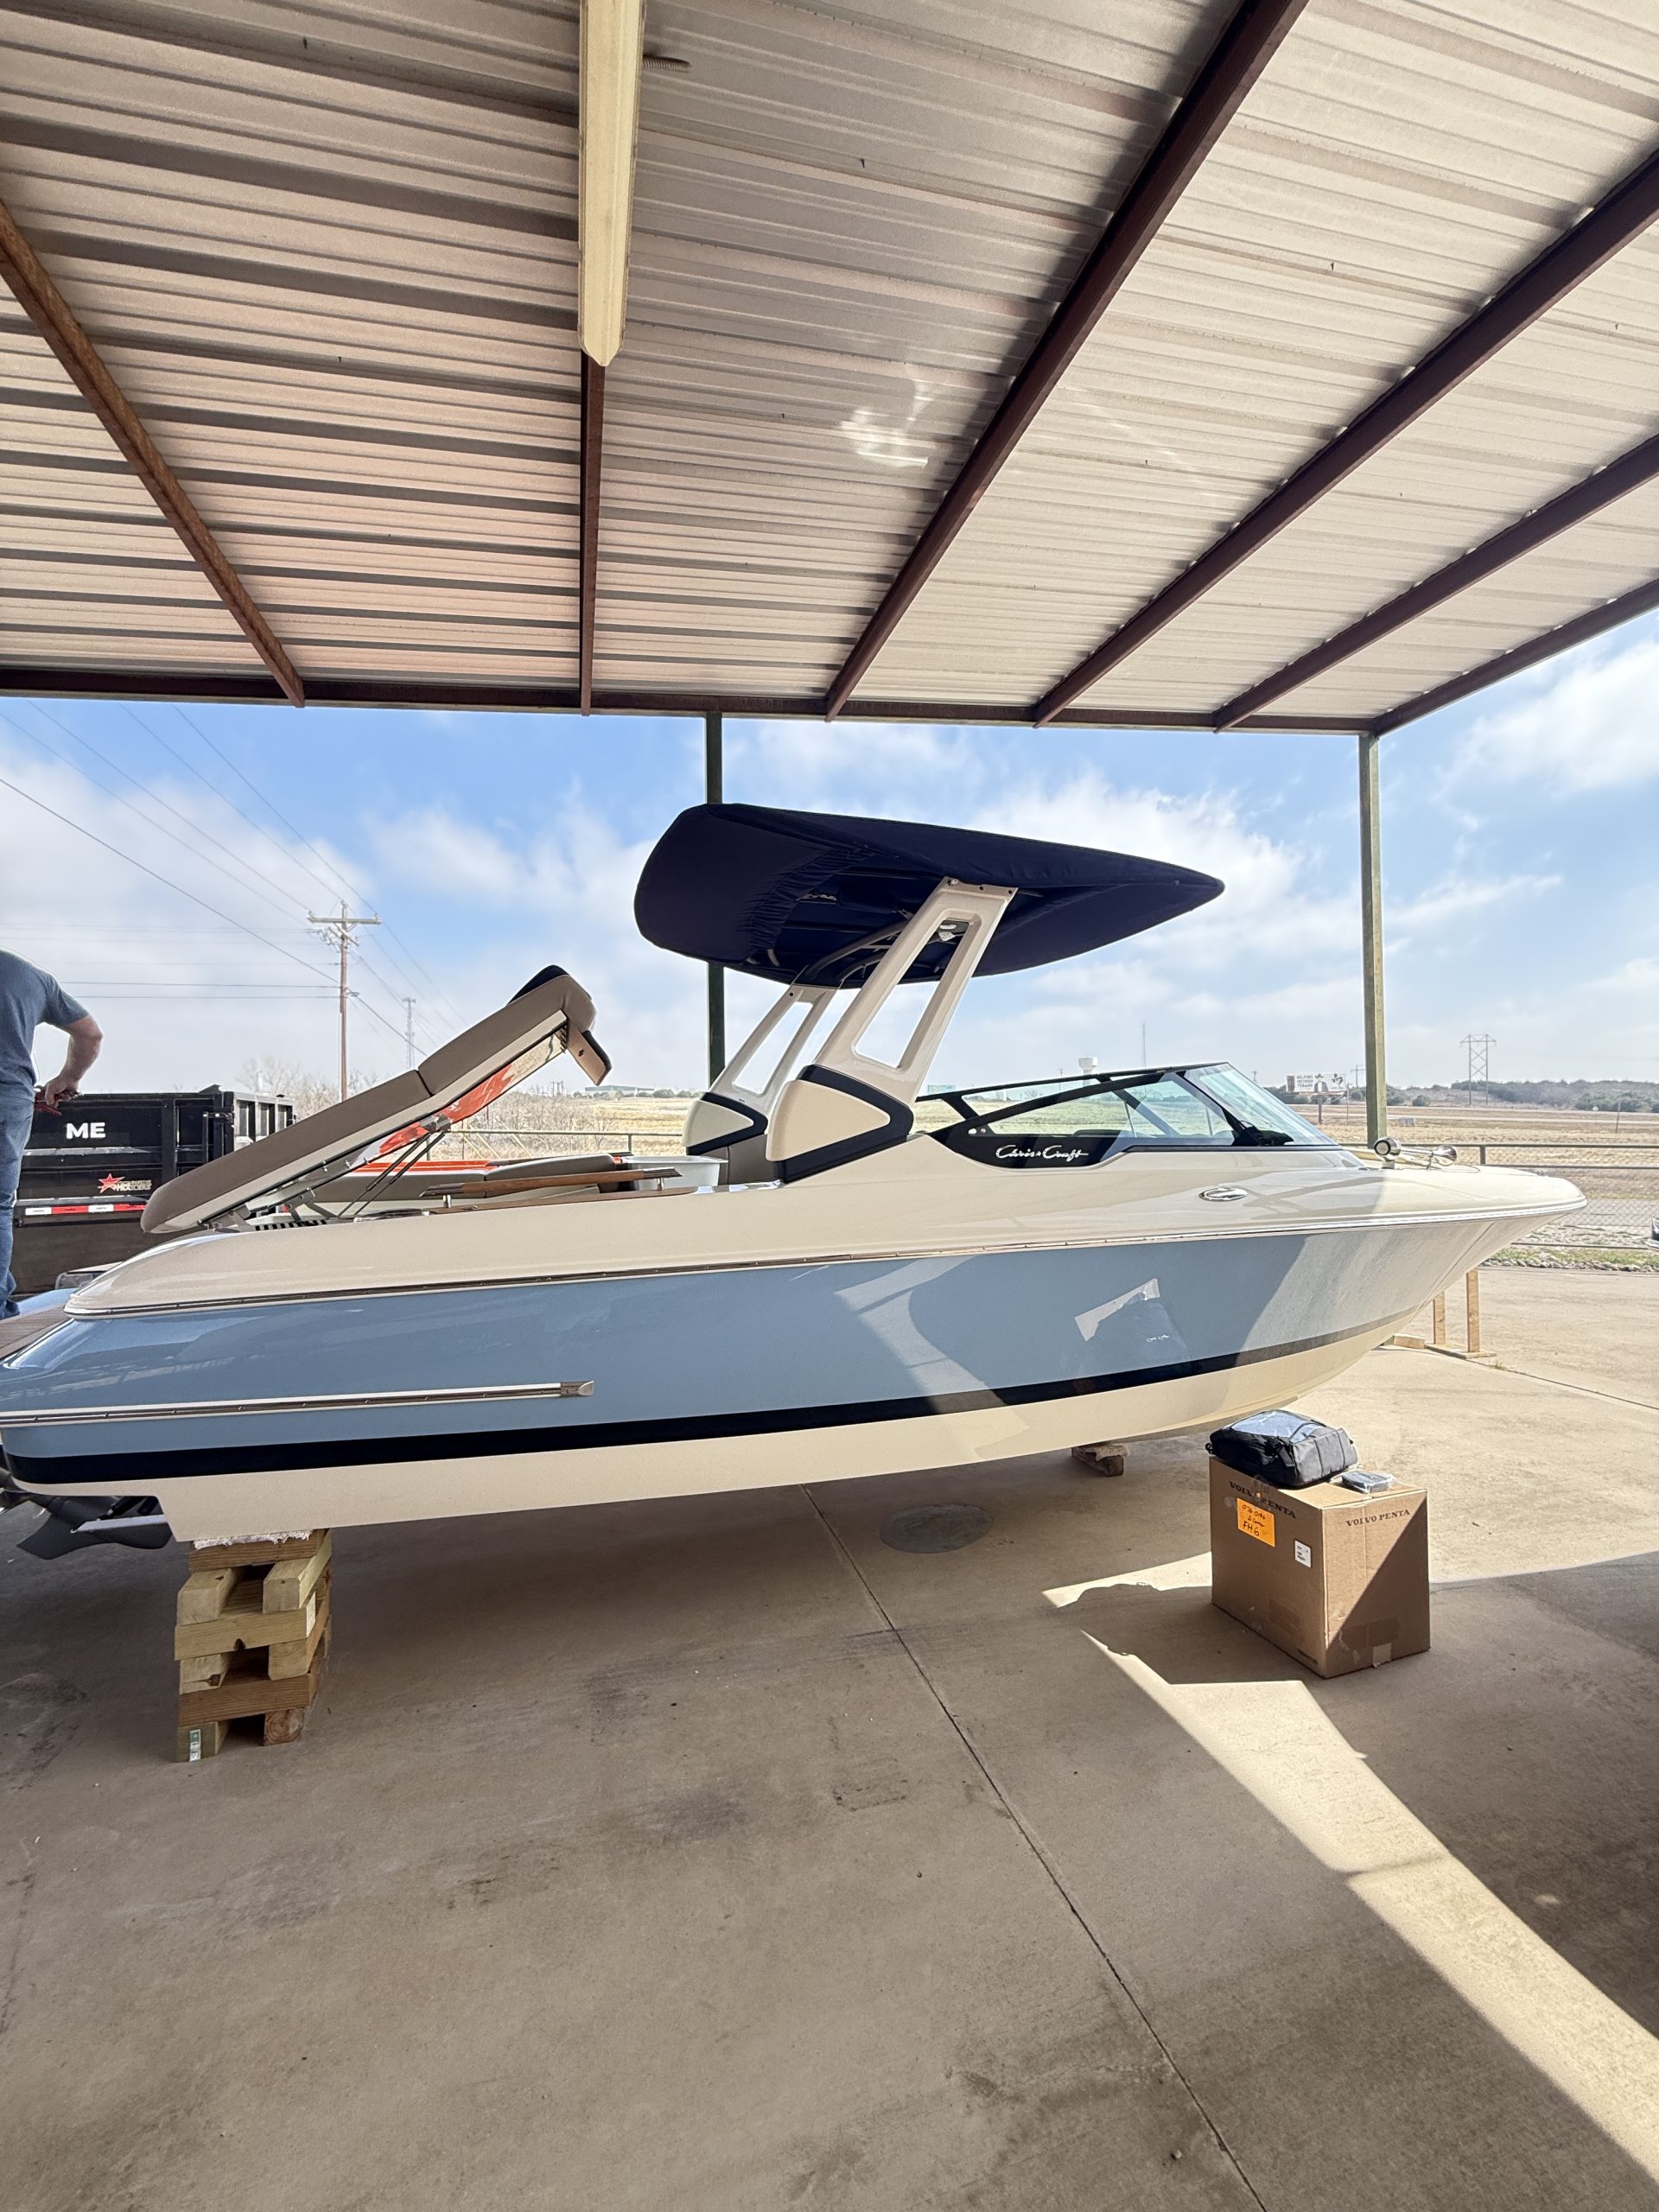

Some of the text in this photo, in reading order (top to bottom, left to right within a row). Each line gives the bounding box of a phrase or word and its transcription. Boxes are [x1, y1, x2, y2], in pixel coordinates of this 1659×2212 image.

[66, 1122, 106, 1139] ME
[1230, 1480, 1259, 1501] VOLV
[1346, 1509, 1411, 1527] VOLVO PENTA
